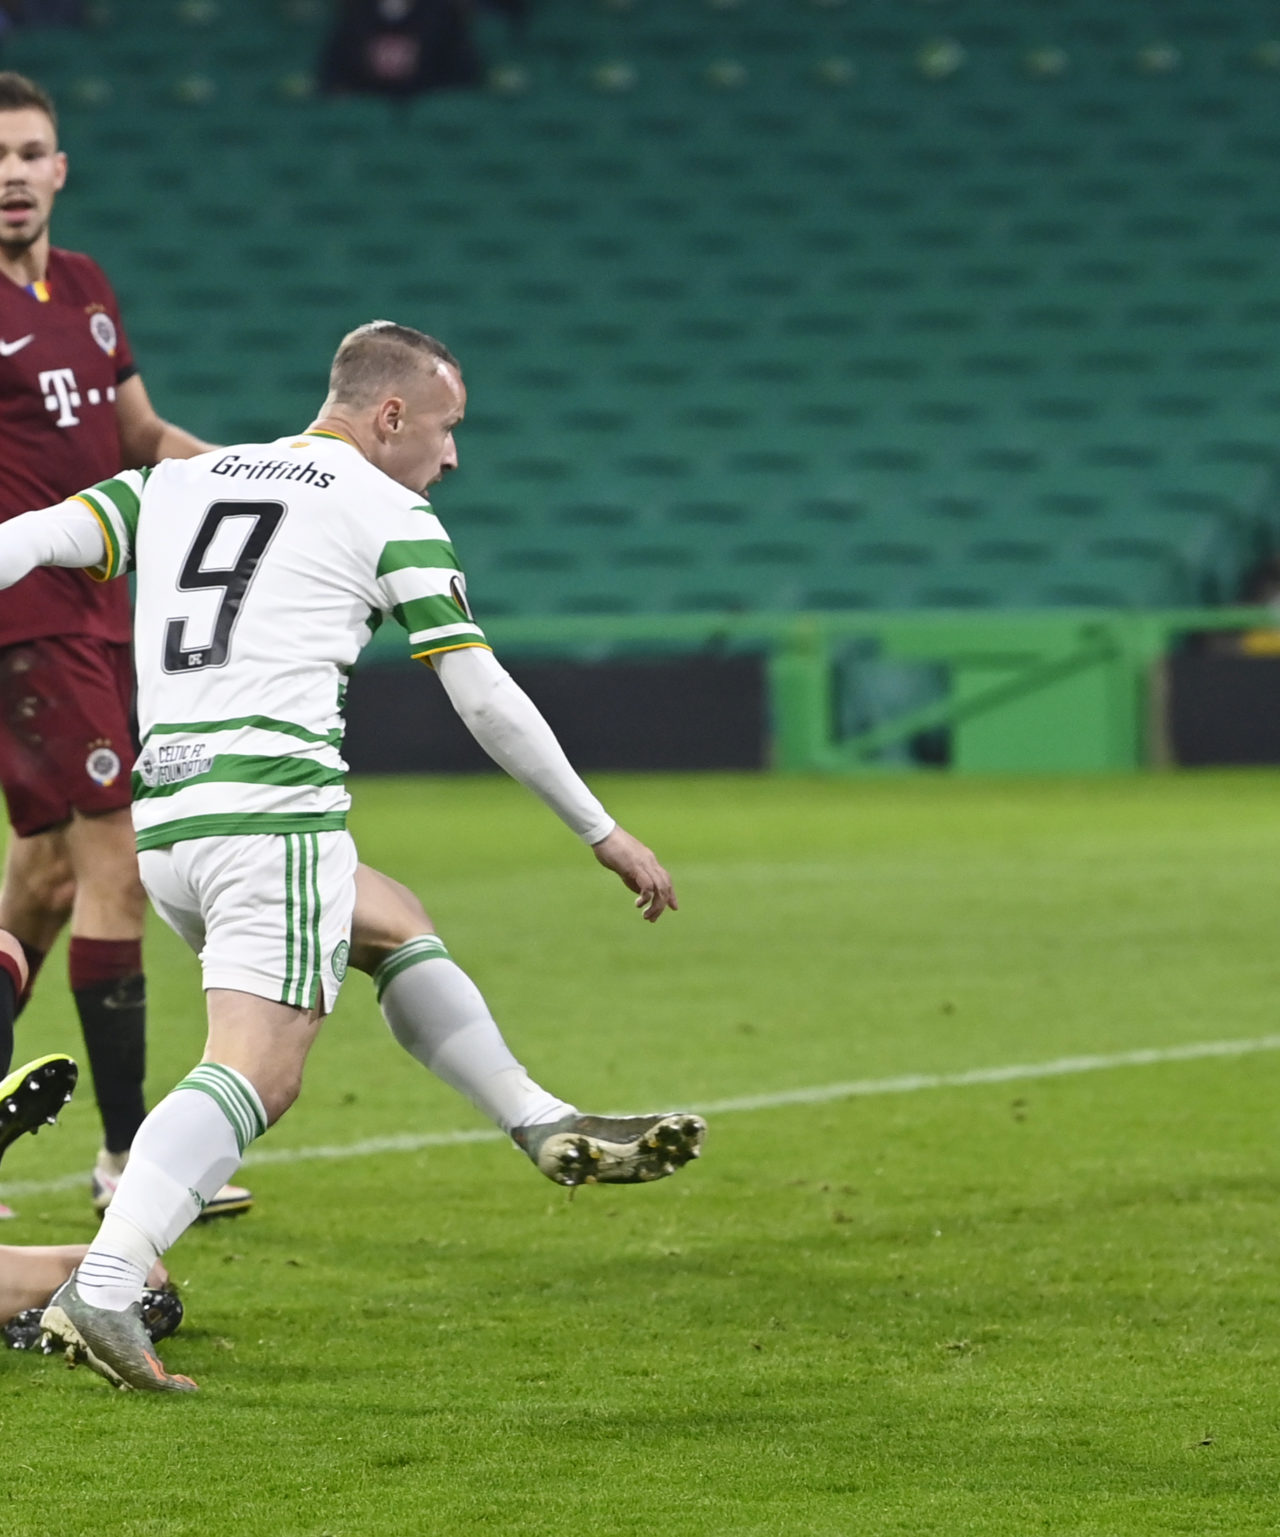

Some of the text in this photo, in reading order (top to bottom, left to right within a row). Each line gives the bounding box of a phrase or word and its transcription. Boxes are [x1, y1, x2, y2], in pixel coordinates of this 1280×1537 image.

[210, 455, 335, 488] Griffiths
[161, 499, 288, 675] 9
[158, 745, 191, 763] CELTIC
